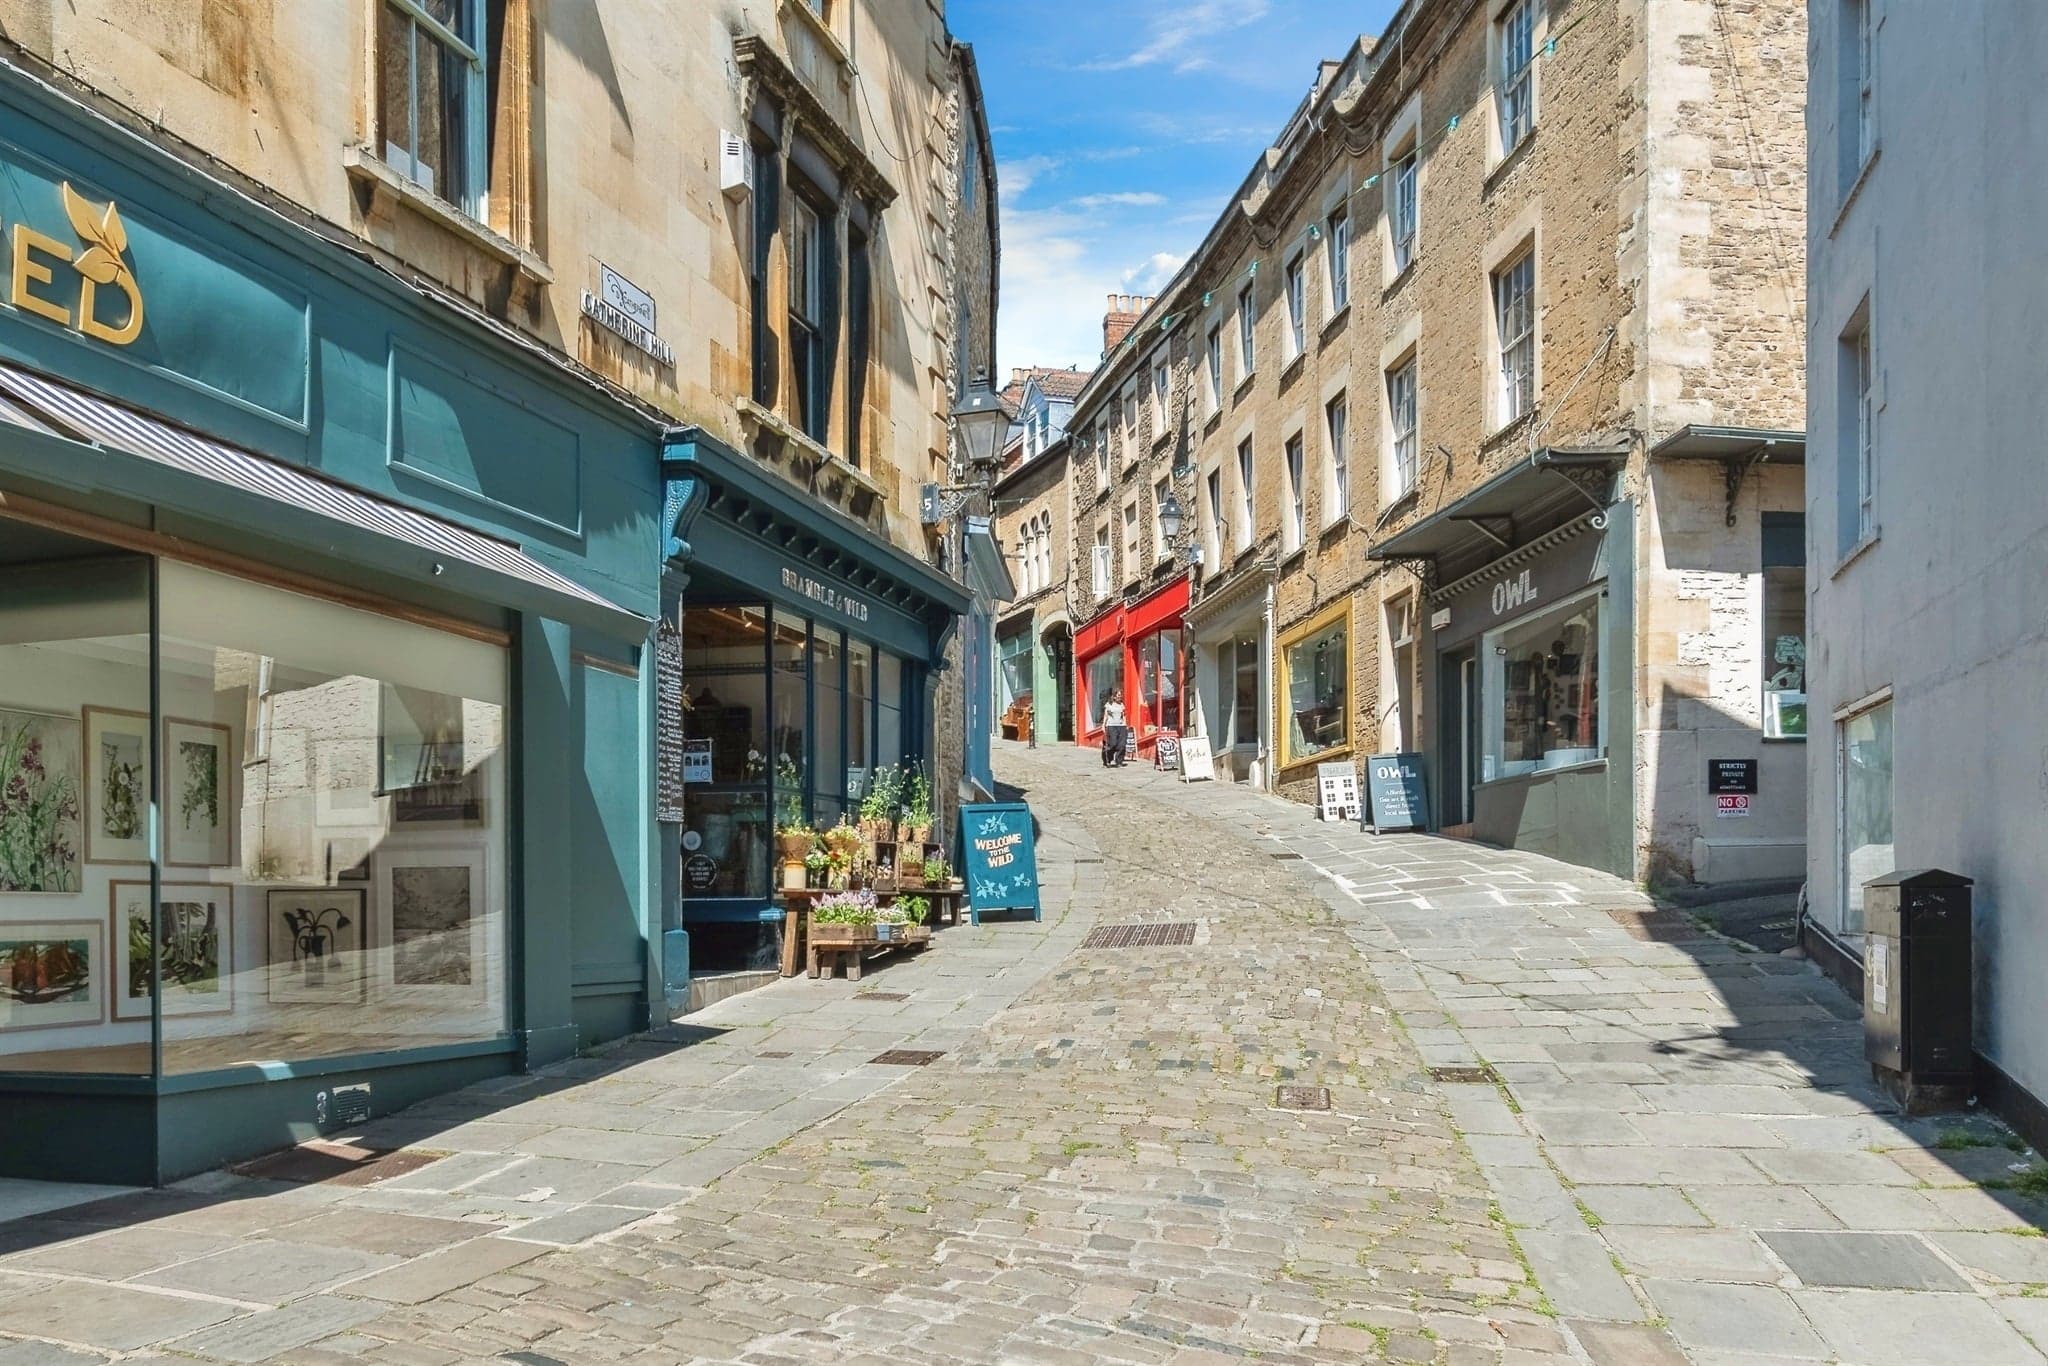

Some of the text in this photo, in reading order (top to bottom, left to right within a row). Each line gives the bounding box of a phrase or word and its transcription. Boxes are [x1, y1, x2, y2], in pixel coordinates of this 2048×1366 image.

[0, 215, 143, 345] ED
[585, 294, 646, 349] CATHERINE
[651, 335, 675, 365] HILL
[781, 567, 868, 622] BRAMBLE & WILD
[1492, 569, 1537, 615] OWL
[1377, 766, 1416, 779] OWL
[1719, 798, 1733, 807] NO
[974, 833, 1022, 851] WELCOME
[987, 853, 1014, 868] WILD
